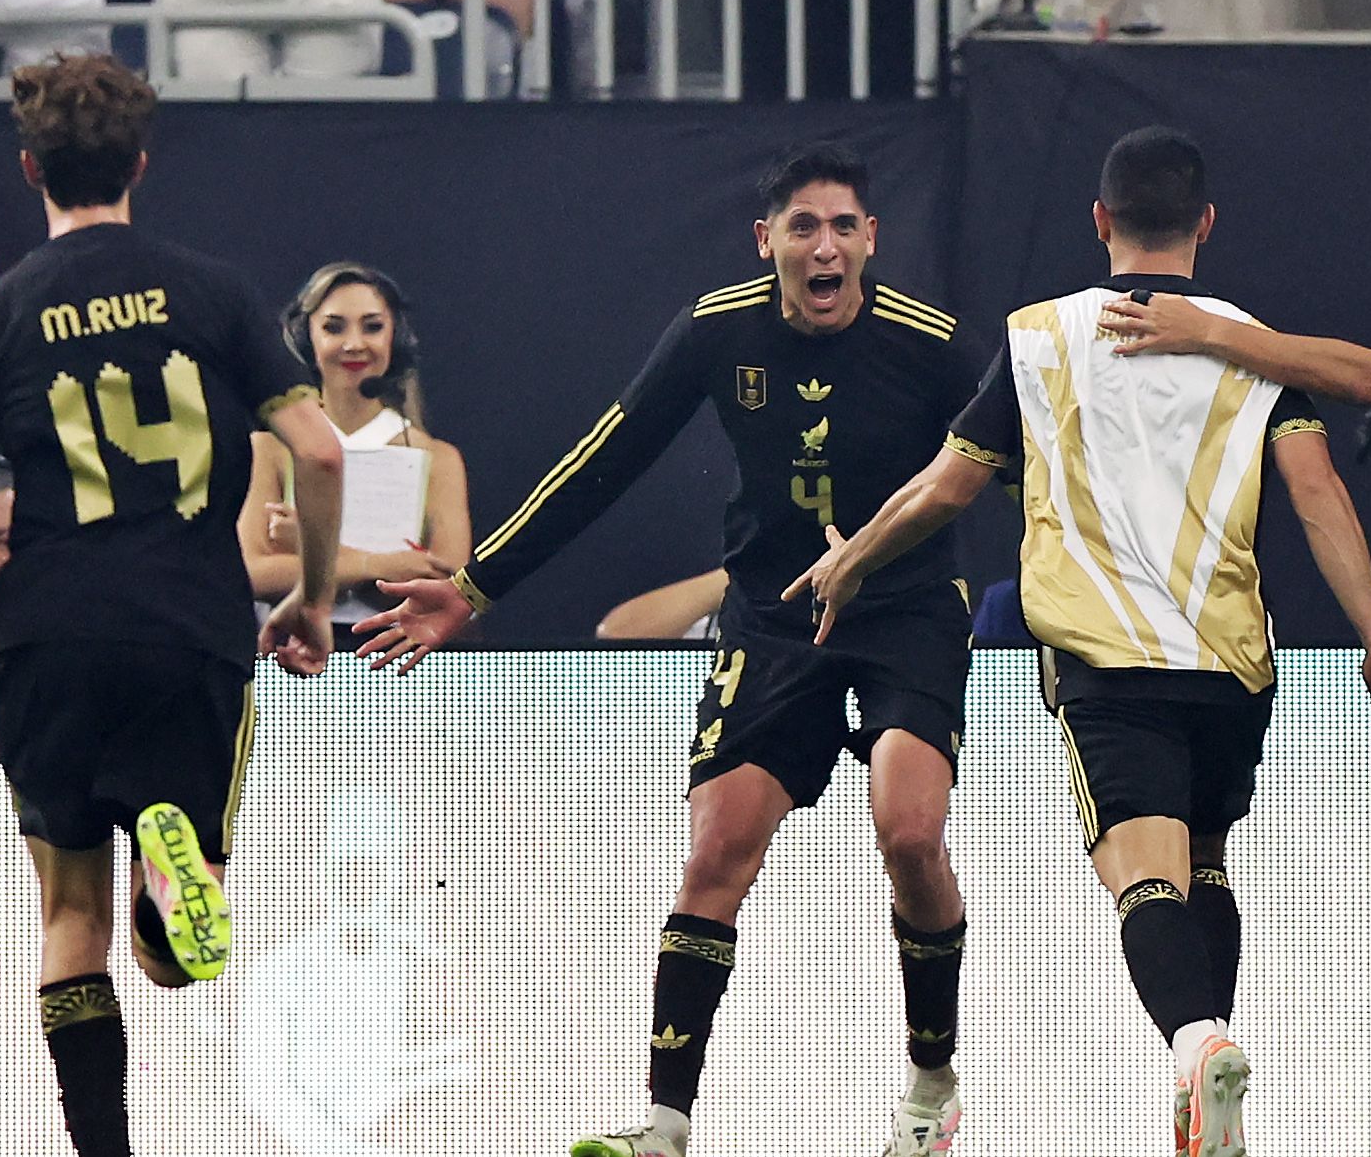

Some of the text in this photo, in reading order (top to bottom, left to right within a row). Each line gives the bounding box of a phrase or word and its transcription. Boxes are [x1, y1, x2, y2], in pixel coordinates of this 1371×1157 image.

[40, 288, 169, 343] M.RUIZ
[47, 349, 213, 525] 14
[791, 474, 833, 527] 4
[710, 648, 746, 708] 4
[155, 810, 226, 965] PREDATOR
